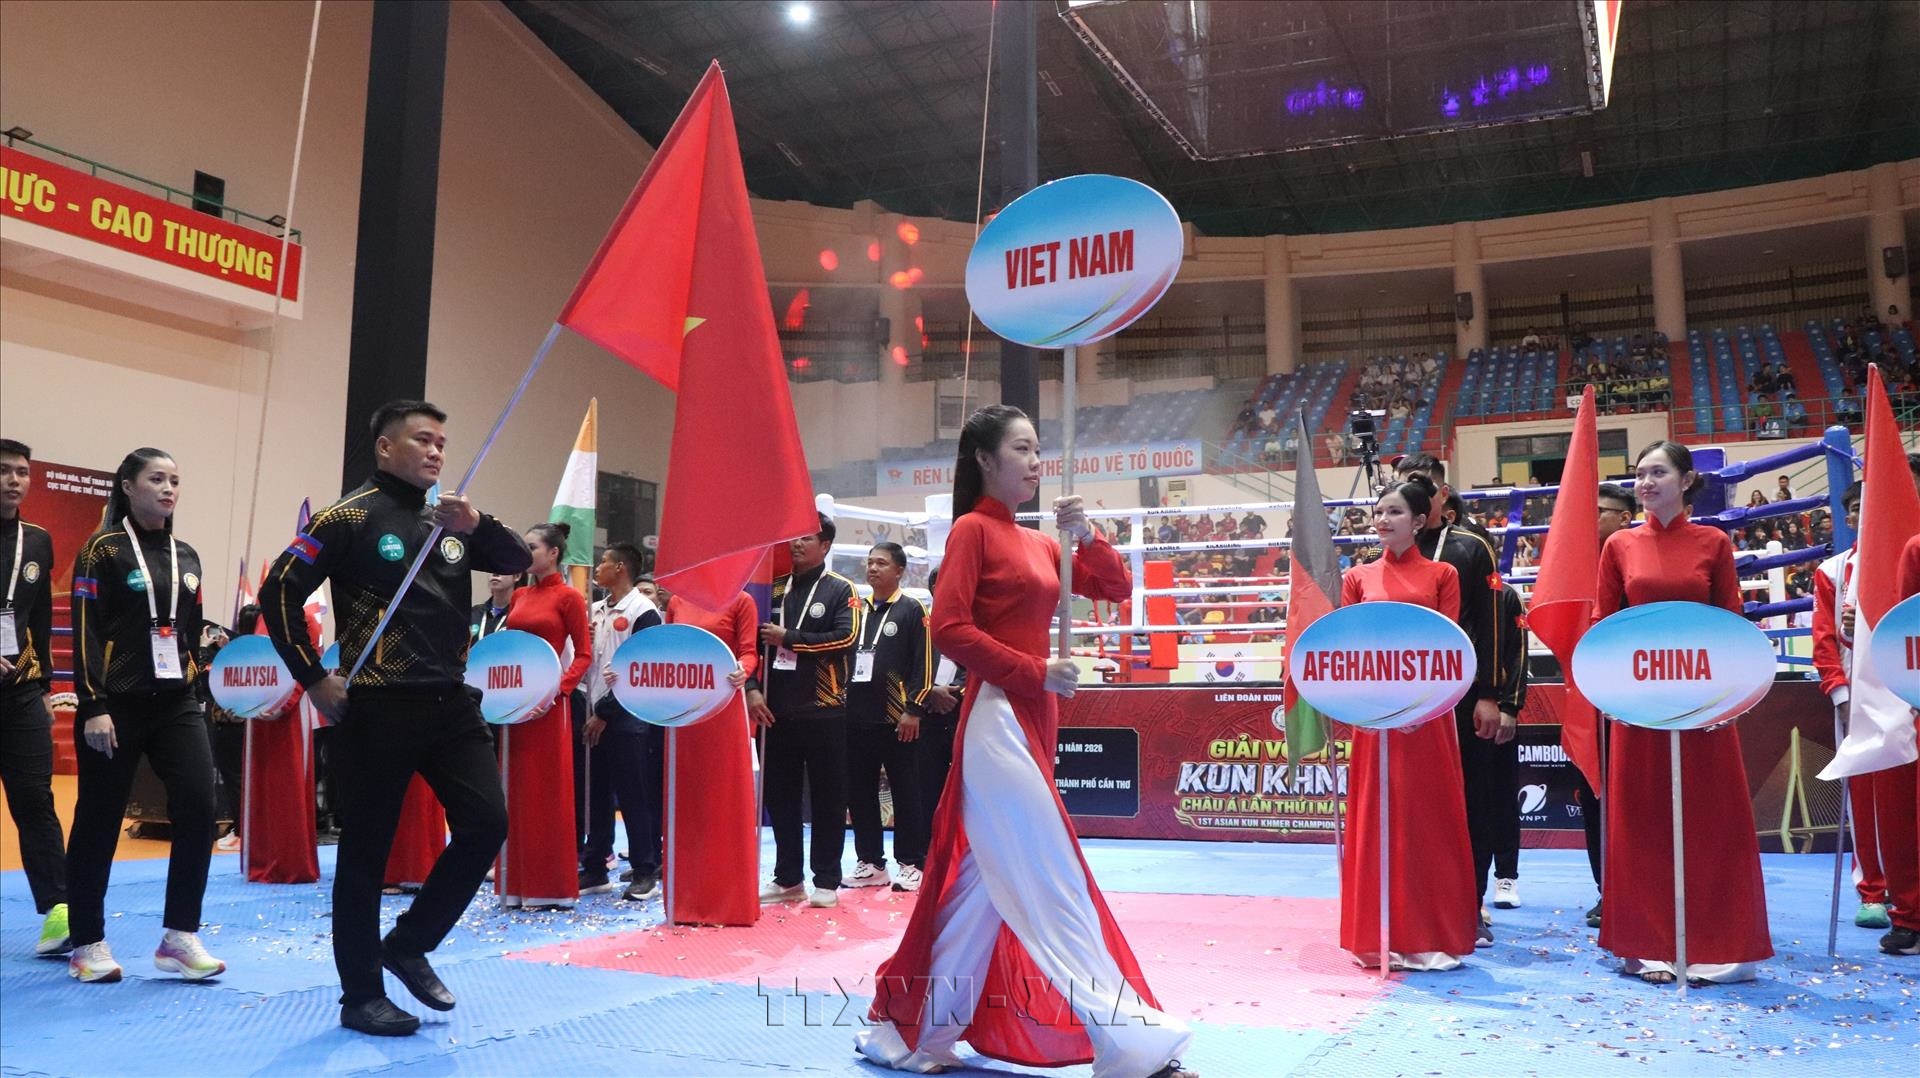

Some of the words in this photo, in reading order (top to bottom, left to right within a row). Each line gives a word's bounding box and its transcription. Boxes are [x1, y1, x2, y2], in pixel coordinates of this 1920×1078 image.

[91, 197, 153, 243] CAO
[163, 219, 273, 281] THƯỢNG
[1005, 241, 1060, 290] VIET
[1069, 229, 1133, 279] NAM
[1105, 451, 1124, 476] VỆ
[1128, 447, 1147, 471] TỔ
[1152, 443, 1194, 470] QUỐC
[223, 665, 279, 687] MALAYSIA
[488, 664, 523, 690] INDIA
[629, 661, 715, 690] CAMBODIA
[1303, 649, 1463, 681] AFGHANISTAN
[1633, 649, 1711, 681] CHINA
[1215, 693, 1235, 702] LIÊN
[1237, 693, 1261, 702] ĐOÀN
[1263, 694, 1282, 702] KUN
[1065, 742, 1083, 753] NĂM
[1084, 744, 1103, 753] 2026
[1210, 733, 1260, 760] GIẢI
[1055, 777, 1080, 788] THÀNH
[1081, 776, 1097, 788] PHỐ
[1098, 777, 1114, 789] CẦN
[1116, 779, 1131, 789] THƠ
[1178, 763, 1257, 794] KUN
[1181, 797, 1224, 812] CHÂU
[1226, 796, 1238, 812] Á
[1241, 794, 1272, 813] LẦN
[1274, 797, 1307, 814] THỨ
[1198, 818, 1212, 826] 1ST
[1214, 818, 1241, 826] ASIAN
[1242, 819, 1259, 827] KUN
[1261, 819, 1291, 828] KHMER
